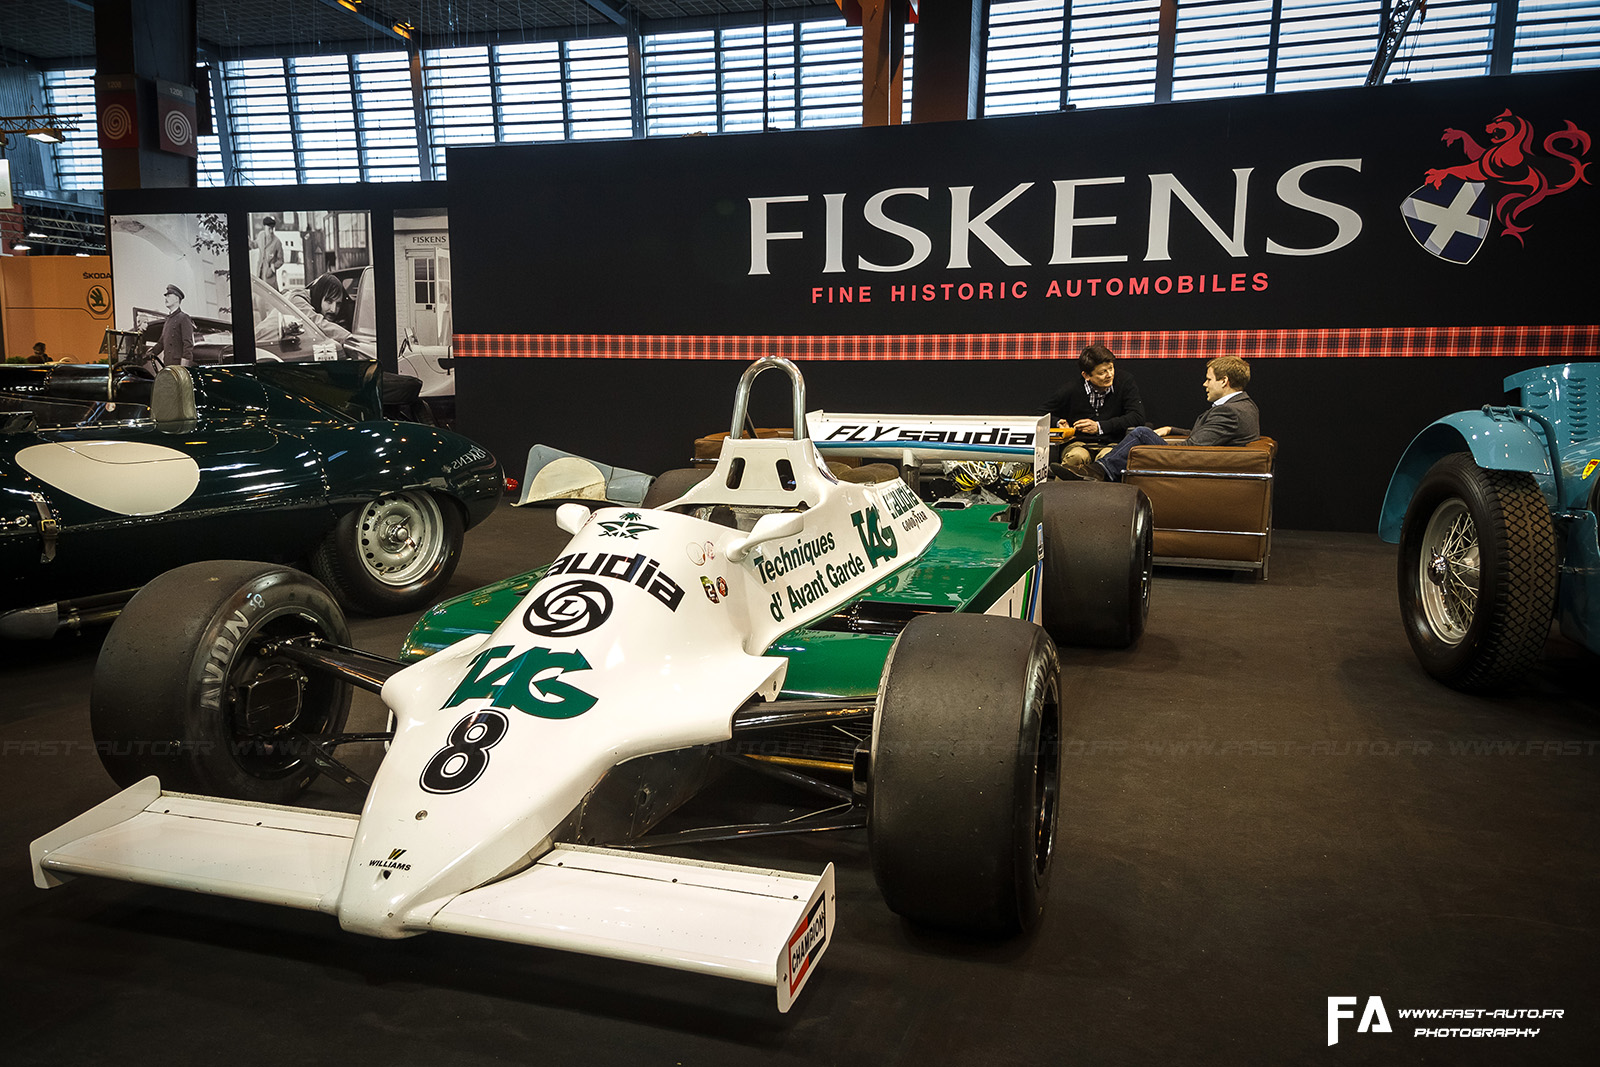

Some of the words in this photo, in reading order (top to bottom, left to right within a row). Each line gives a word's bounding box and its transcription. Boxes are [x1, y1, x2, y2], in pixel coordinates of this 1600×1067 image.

[412, 235, 447, 244] FISKENS
[747, 158, 1363, 275] FISKENS
[811, 286, 872, 304] FINE
[891, 280, 1028, 302] HISTORIC
[1045, 272, 1270, 298] AUTOMOBILES
[825, 425, 900, 441] FLY
[896, 427, 1036, 446] saudia
[542, 552, 687, 613] audia
[753, 531, 836, 585] Techniques
[786, 569, 830, 614] Avant
[825, 552, 866, 589] Garde
[200, 608, 250, 710] AVON
[418, 708, 510, 795] 8
[369, 859, 412, 872] WILLIAMS
[791, 910, 825, 974] CHAMPION
